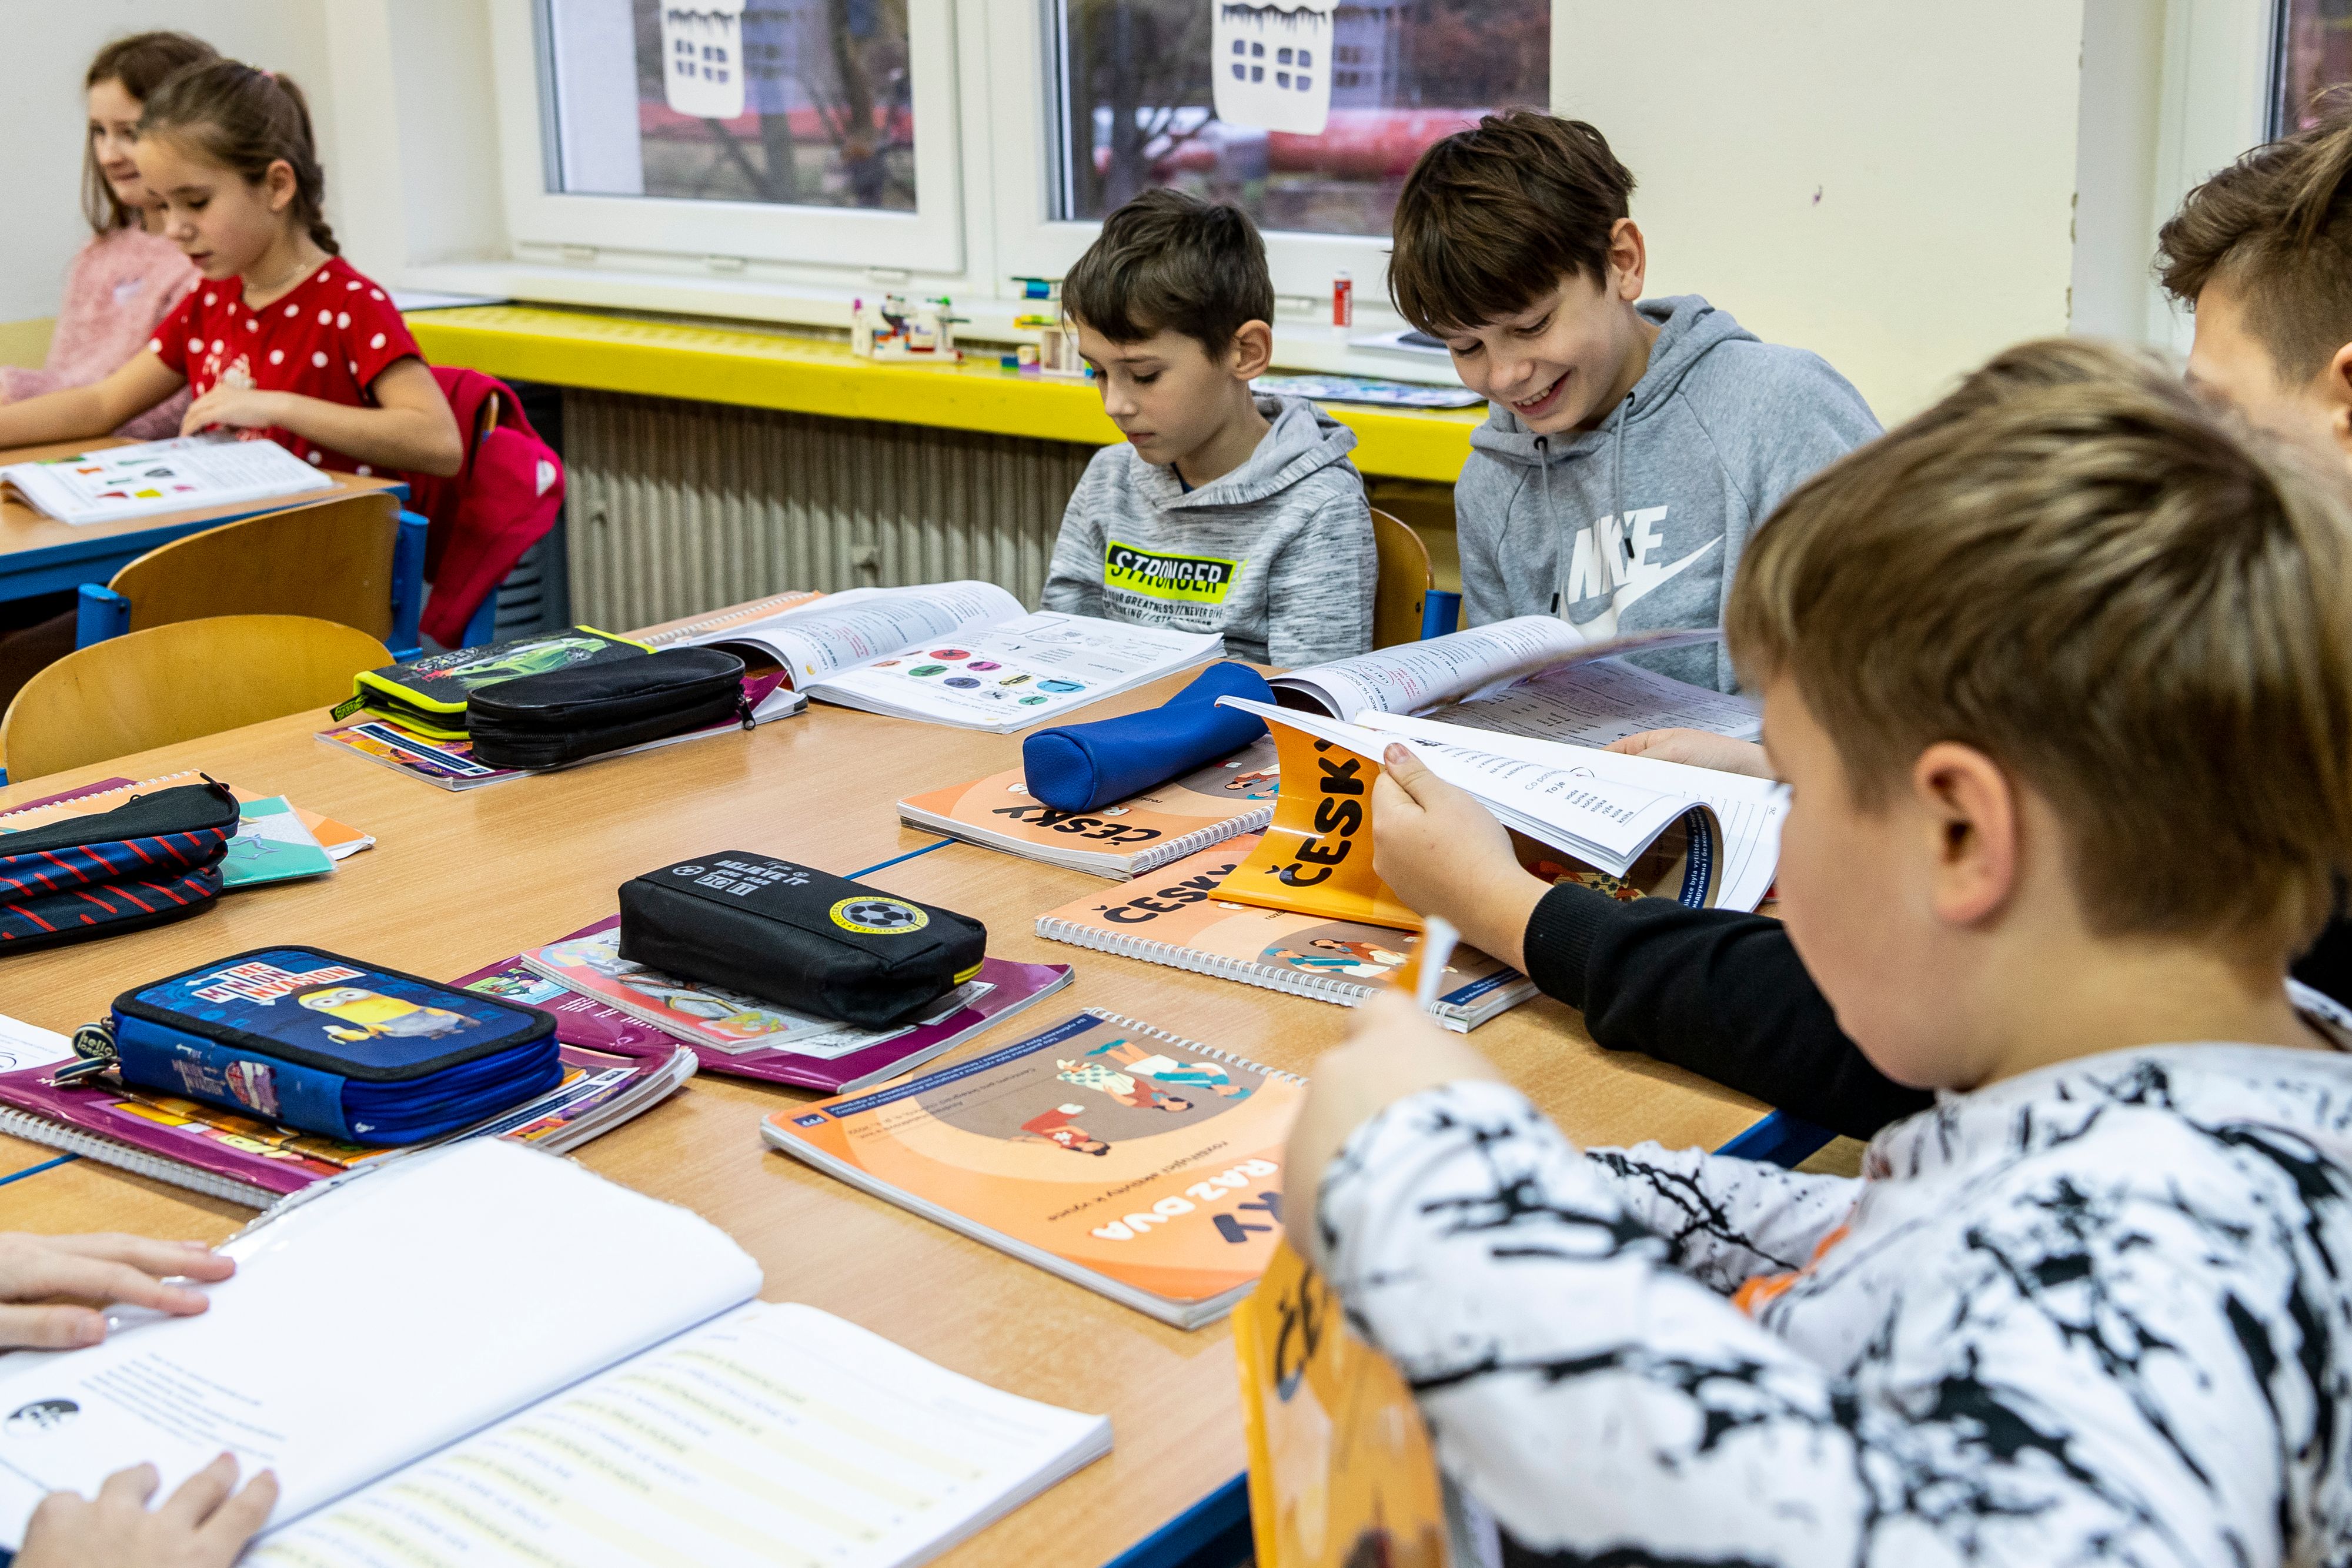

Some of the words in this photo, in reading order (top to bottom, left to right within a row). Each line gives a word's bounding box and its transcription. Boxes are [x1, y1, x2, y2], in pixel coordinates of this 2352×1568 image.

[1111, 550, 1222, 594] STRONGER
[1125, 594, 1174, 614] GREATNESS
[1545, 785, 1559, 795] To
[1564, 789, 1579, 800] voda
[1616, 811, 1635, 824] kniha
[1769, 807, 1777, 815] 26
[991, 805, 1162, 846] ČESKY
[1689, 870, 1698, 885] byla
[219, 964, 272, 986] THE
[79, 1030, 114, 1055] hello
[1184, 1158, 1279, 1202] RAZ
[1090, 1195, 1197, 1241] DVA
